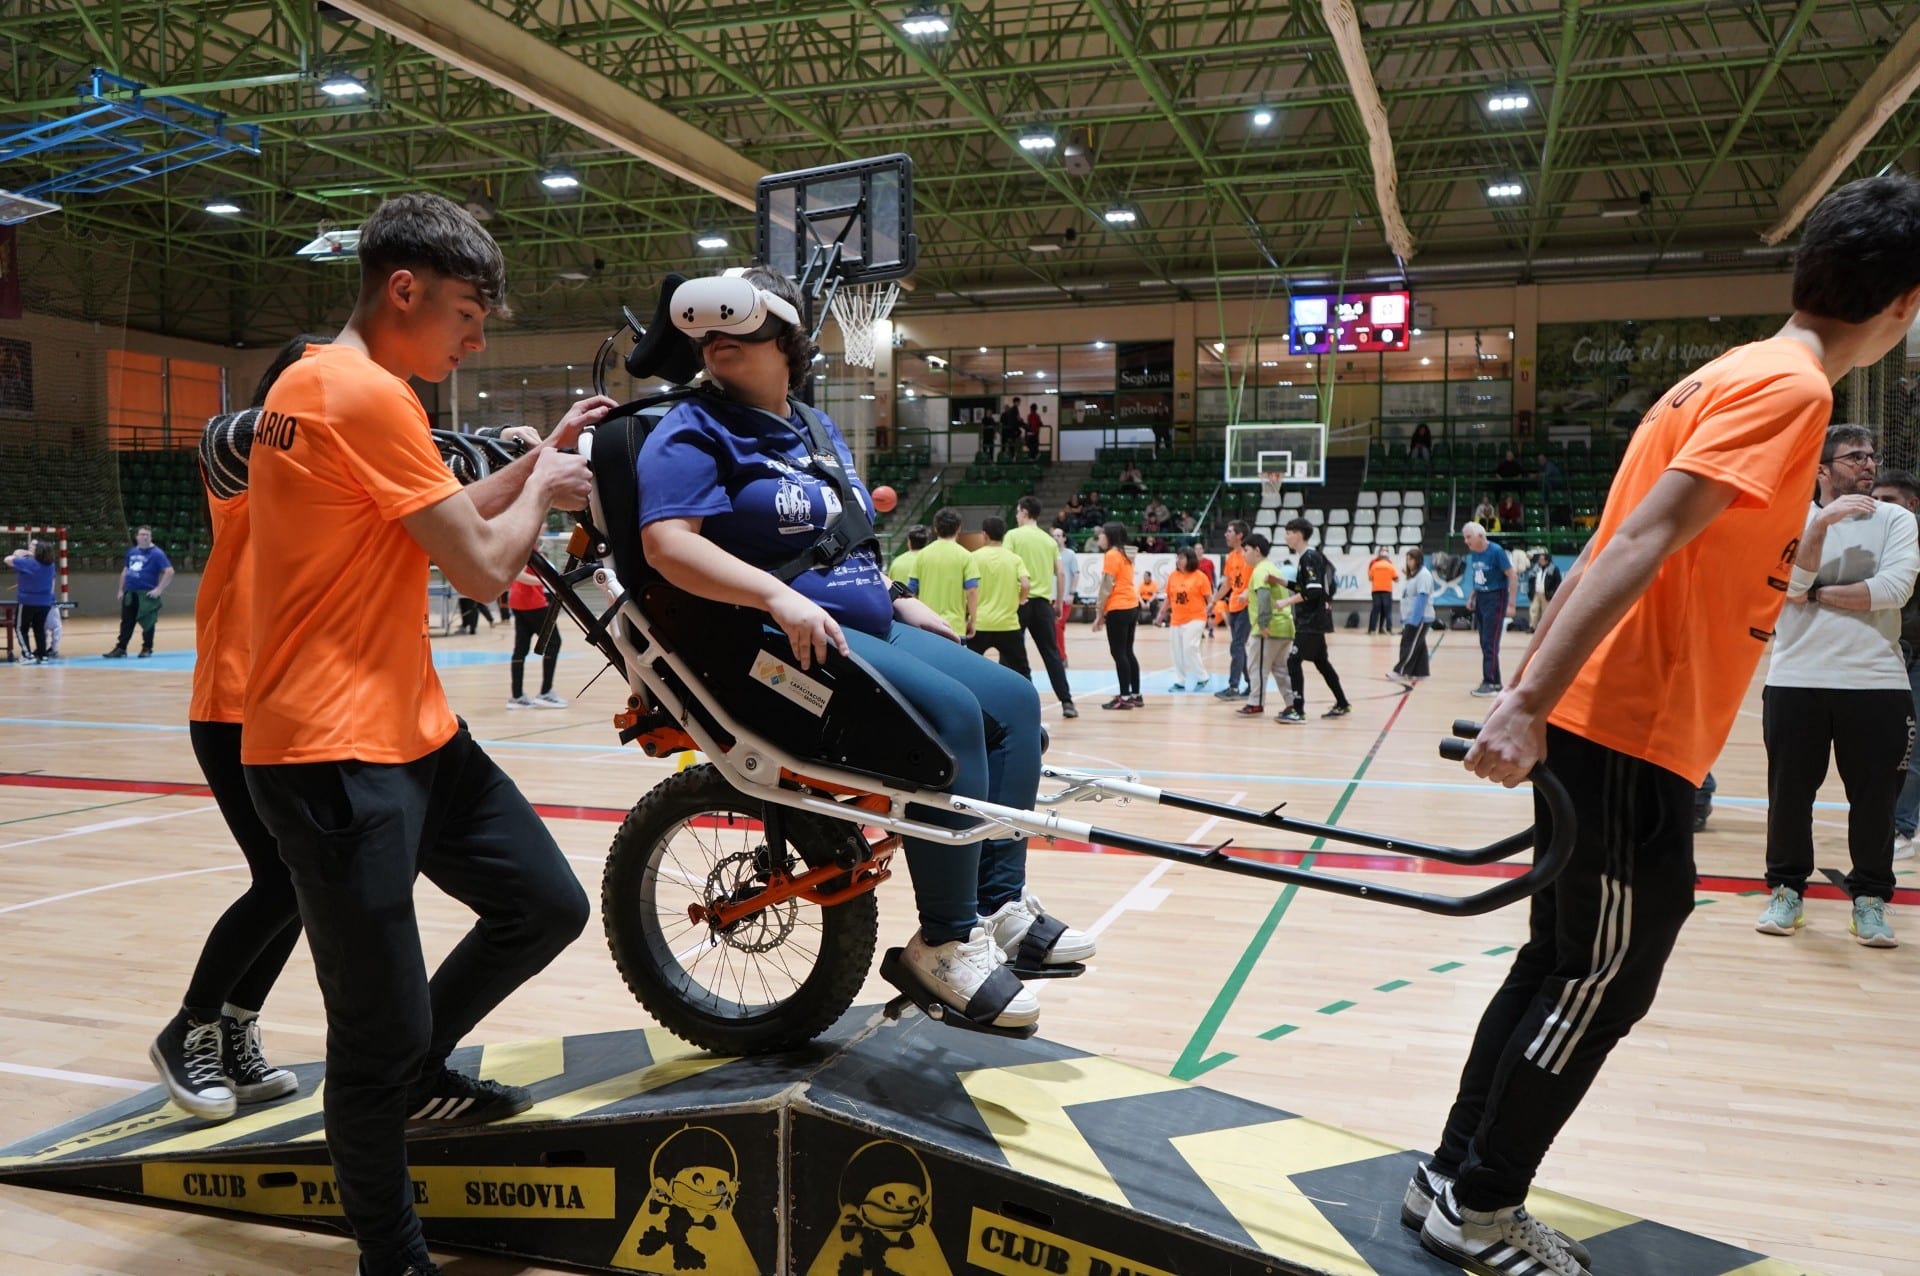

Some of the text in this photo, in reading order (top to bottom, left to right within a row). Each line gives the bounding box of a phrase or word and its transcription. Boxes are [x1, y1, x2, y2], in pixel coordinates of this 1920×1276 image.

[1642, 335, 1665, 360] el
[1121, 370, 1170, 385] Segovia
[183, 1172, 246, 1198] CLUB
[465, 1181, 586, 1209] SEGOVIA
[981, 1226, 1070, 1275] CLUB
